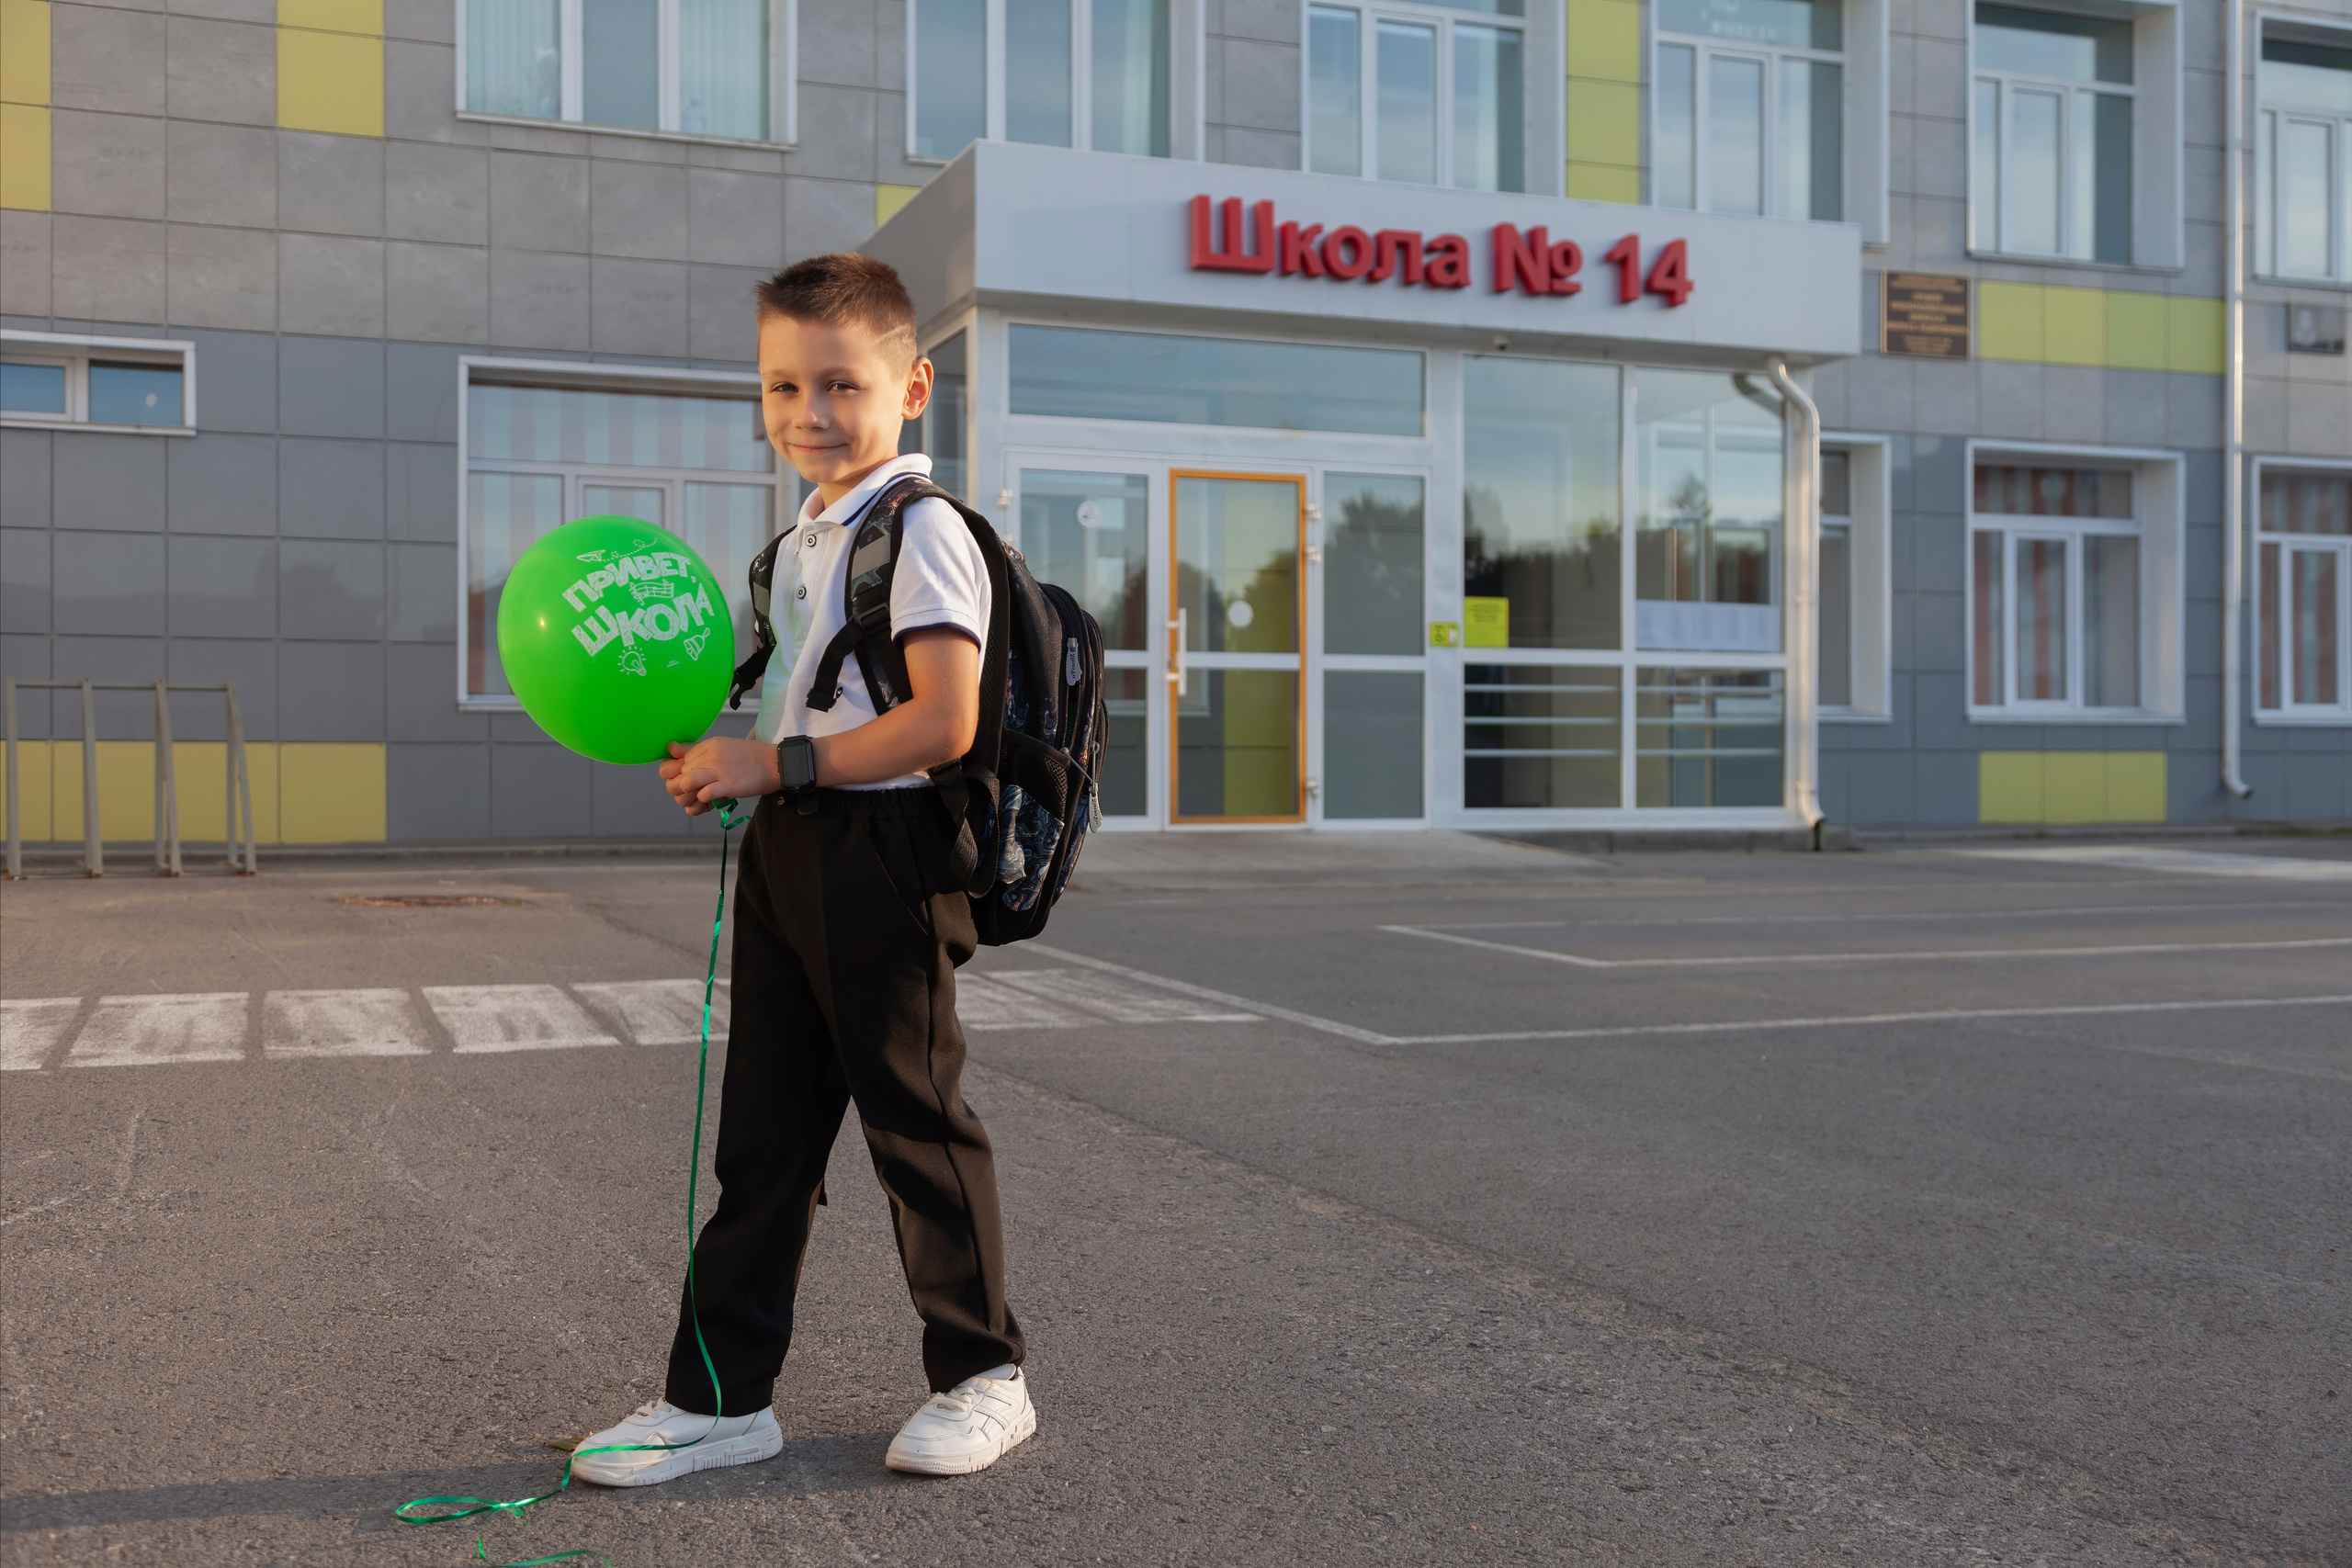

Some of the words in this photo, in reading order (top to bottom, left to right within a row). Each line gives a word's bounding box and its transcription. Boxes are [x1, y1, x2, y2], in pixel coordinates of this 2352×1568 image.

[1188, 194, 1471, 288] Школа
[1492, 222, 1583, 297] №
[1605, 233, 1694, 307] 14
[571, 582, 715, 657] ШКОЛА
